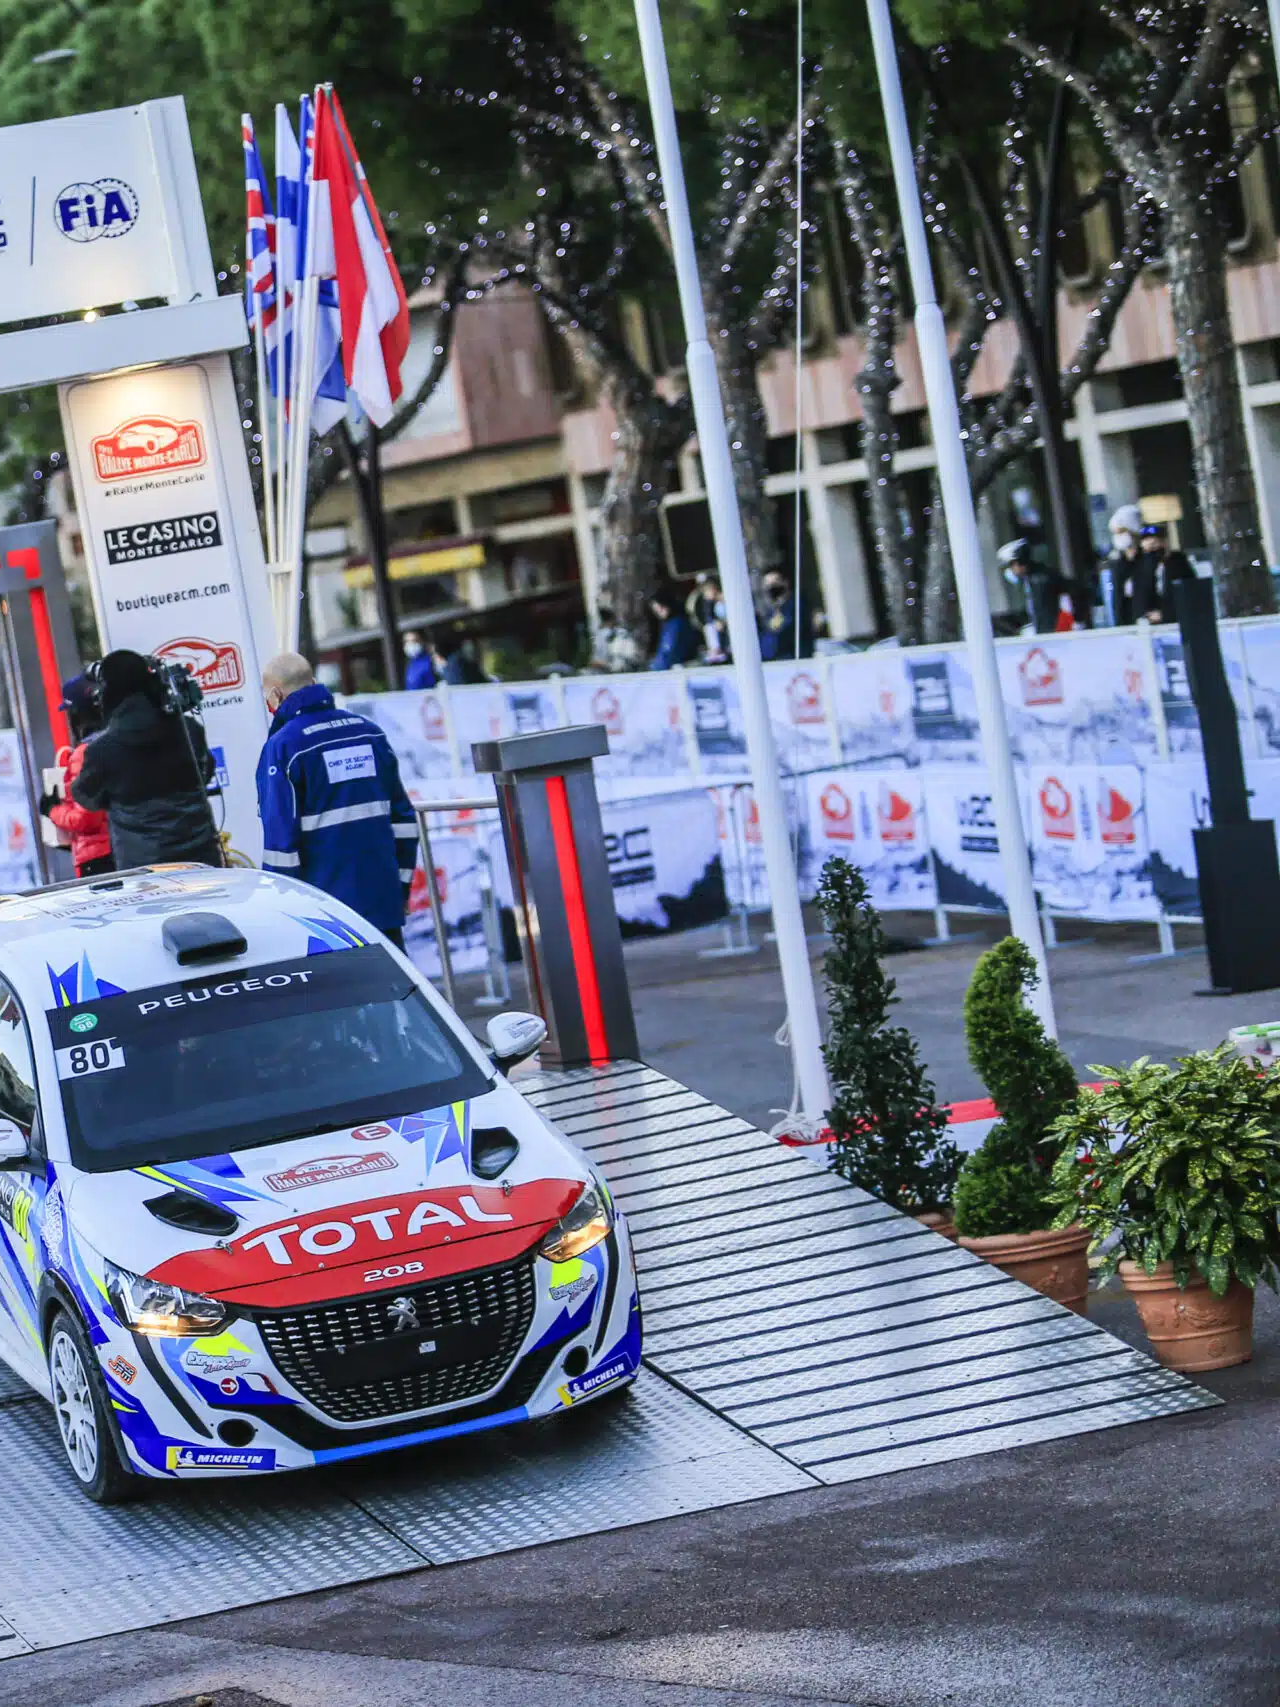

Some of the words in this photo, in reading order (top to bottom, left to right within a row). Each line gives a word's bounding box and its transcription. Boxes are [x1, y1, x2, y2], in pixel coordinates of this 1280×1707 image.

[106, 530, 130, 550] LE
[131, 515, 217, 546] CASINO
[116, 583, 231, 612] boutiqueacm.com
[137, 971, 313, 1015] PEUGEOT
[70, 1042, 110, 1074] 80
[357, 1126, 382, 1140] E
[273, 1176, 313, 1190] RALLYE
[242, 1196, 513, 1266] TOTAL
[363, 1261, 425, 1283] 208
[583, 1363, 625, 1390] MICHELIN
[196, 1454, 264, 1464] MICHELIN
